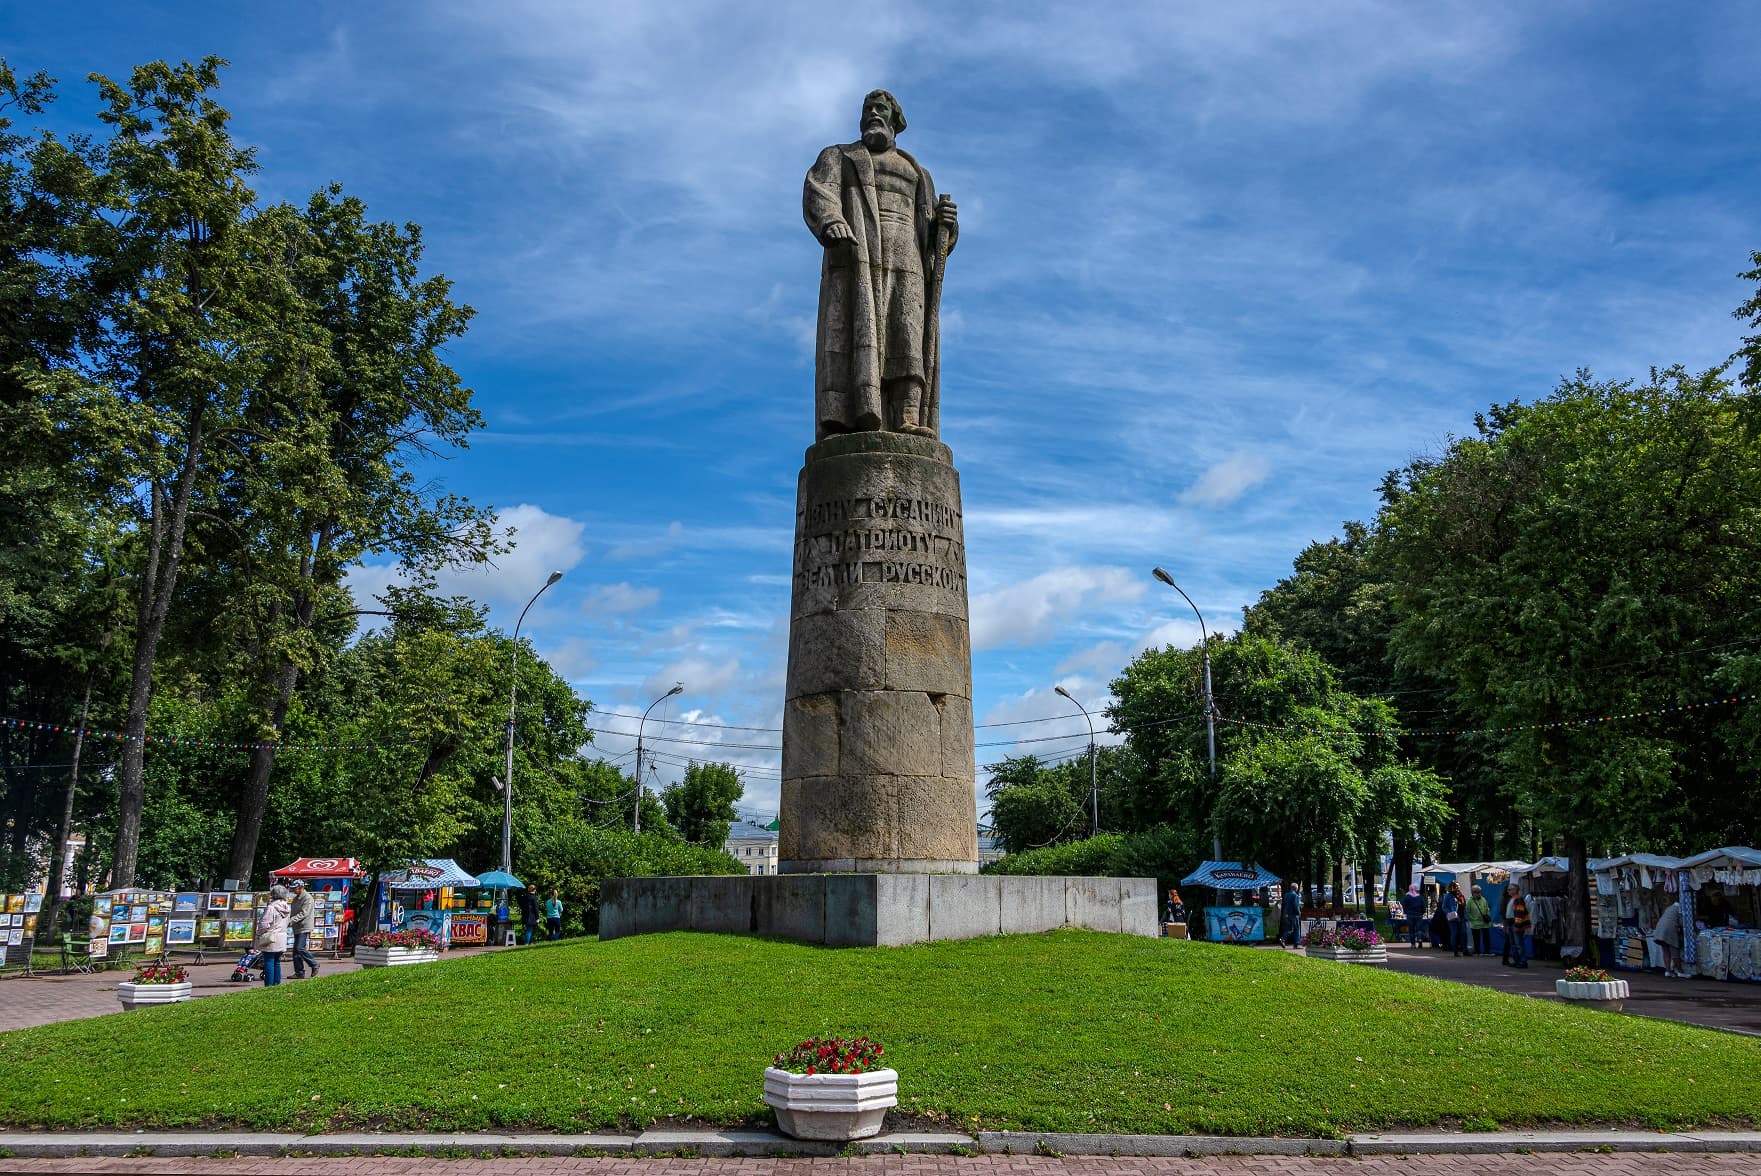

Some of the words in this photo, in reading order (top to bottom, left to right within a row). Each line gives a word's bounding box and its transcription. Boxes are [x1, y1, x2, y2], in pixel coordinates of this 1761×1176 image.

[870, 499, 956, 529] СУСАНИНУ
[831, 529, 935, 555] ПАТРИОТУ
[451, 923, 482, 937] КВАС
